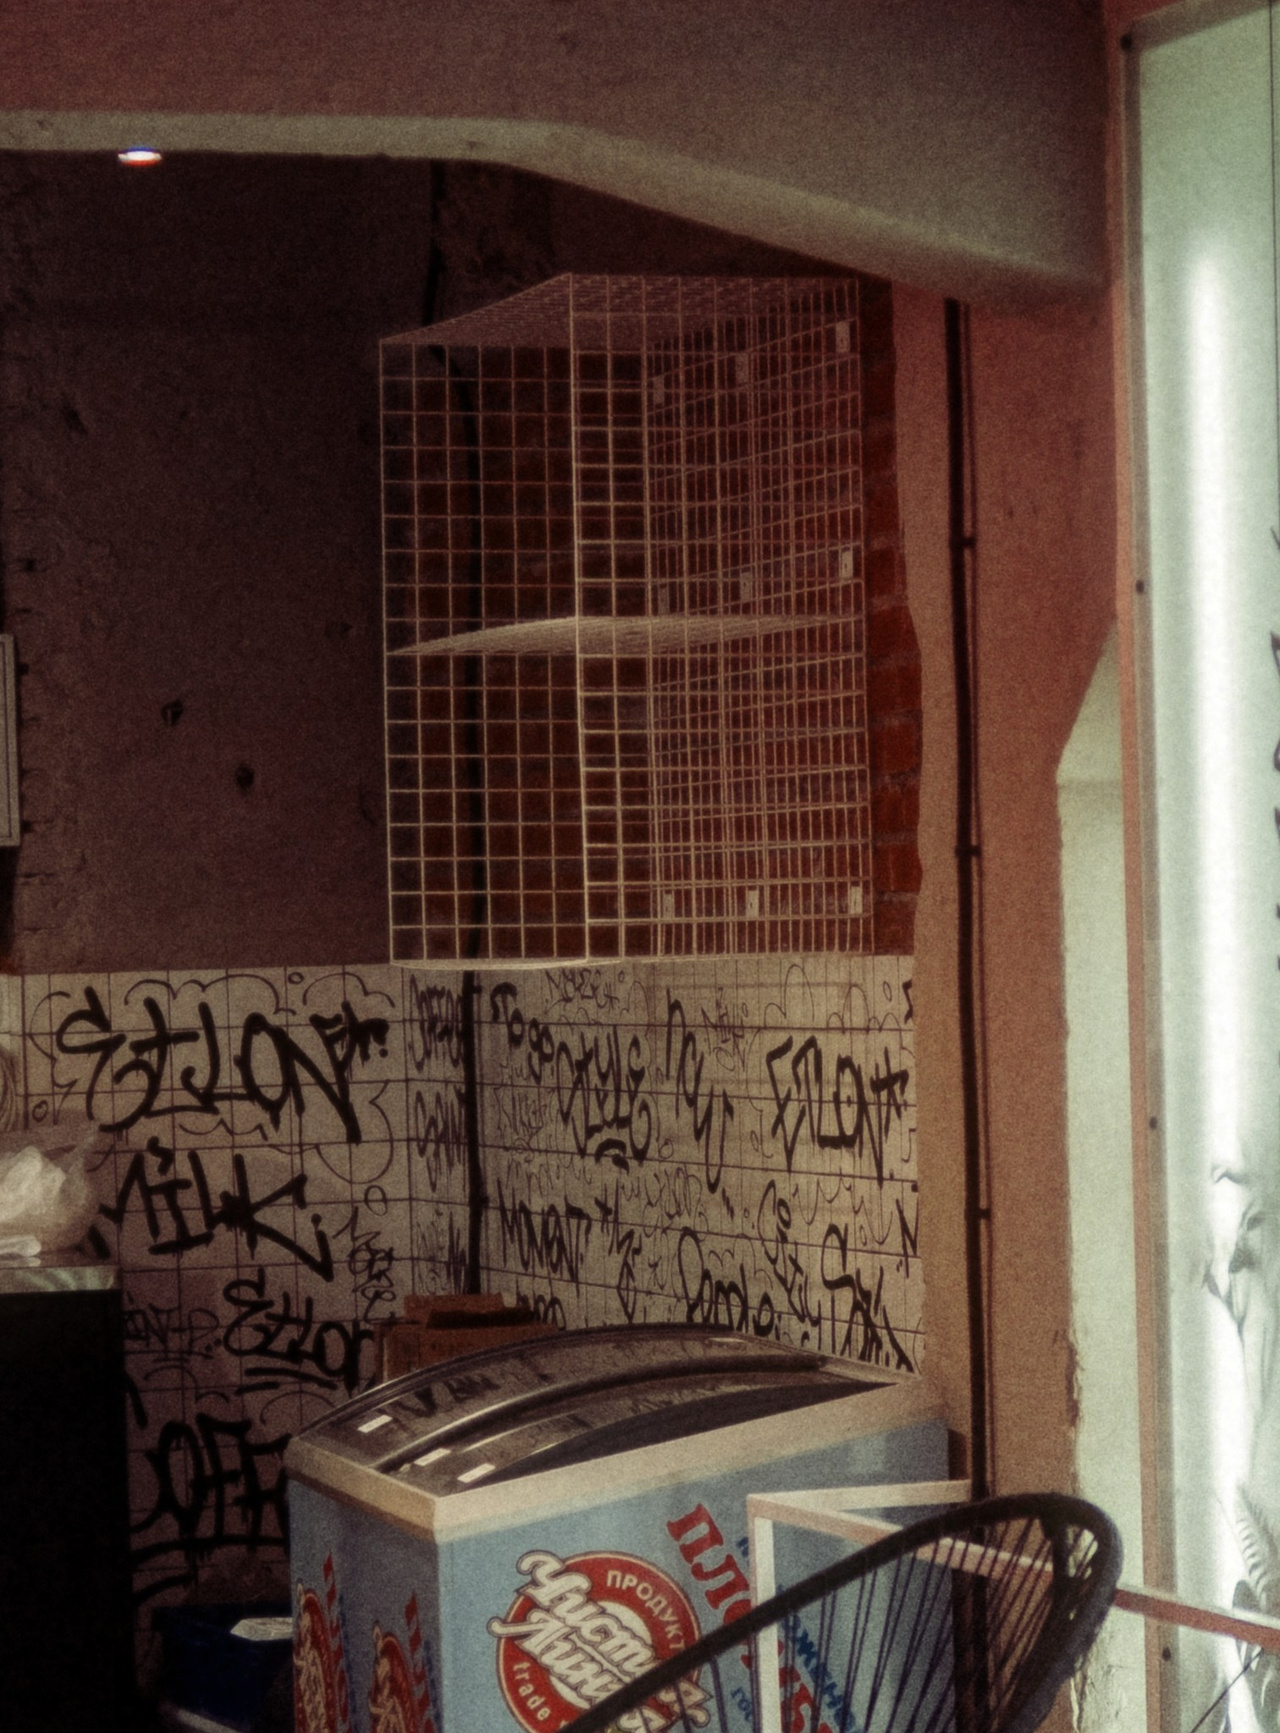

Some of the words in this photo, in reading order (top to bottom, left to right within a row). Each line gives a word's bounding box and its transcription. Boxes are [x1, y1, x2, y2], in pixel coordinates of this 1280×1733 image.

[515, 1550, 712, 1728] Чистя
[606, 1569, 685, 1650] ПРОДУКТ
[513, 1661, 552, 1722] trade
